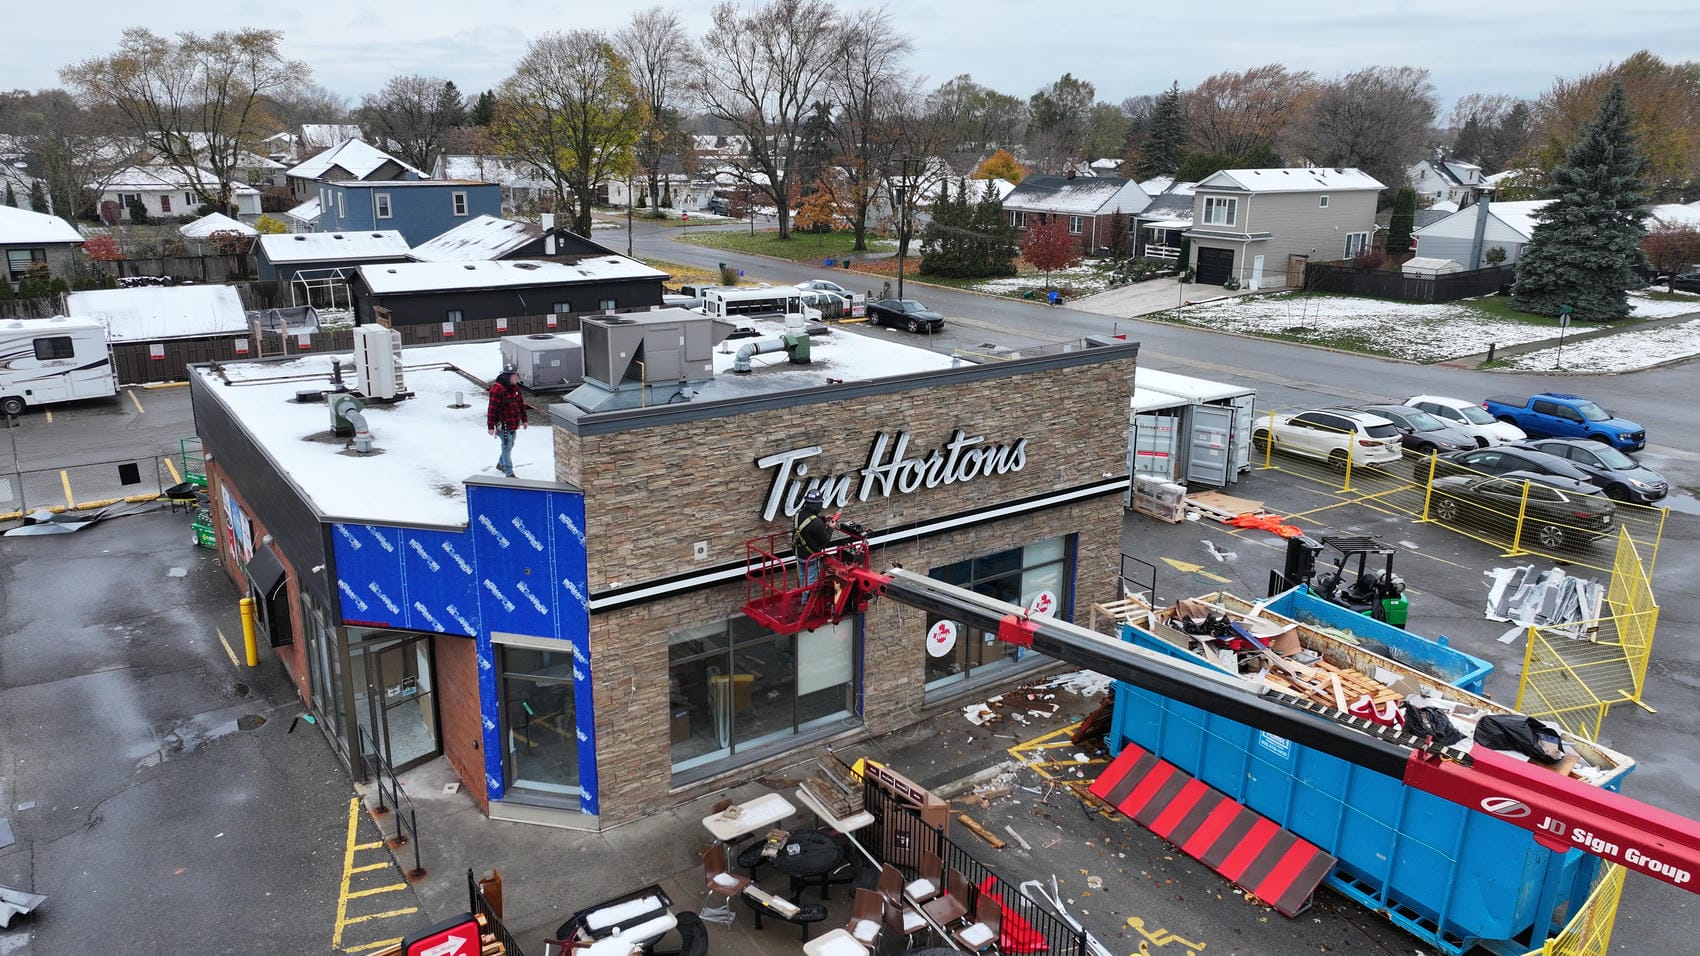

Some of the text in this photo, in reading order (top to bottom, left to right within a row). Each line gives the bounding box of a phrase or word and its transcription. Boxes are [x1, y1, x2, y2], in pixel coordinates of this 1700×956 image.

[757, 430, 1028, 522] Tim Hortons
[1537, 816, 1691, 884] JD Sign Group
